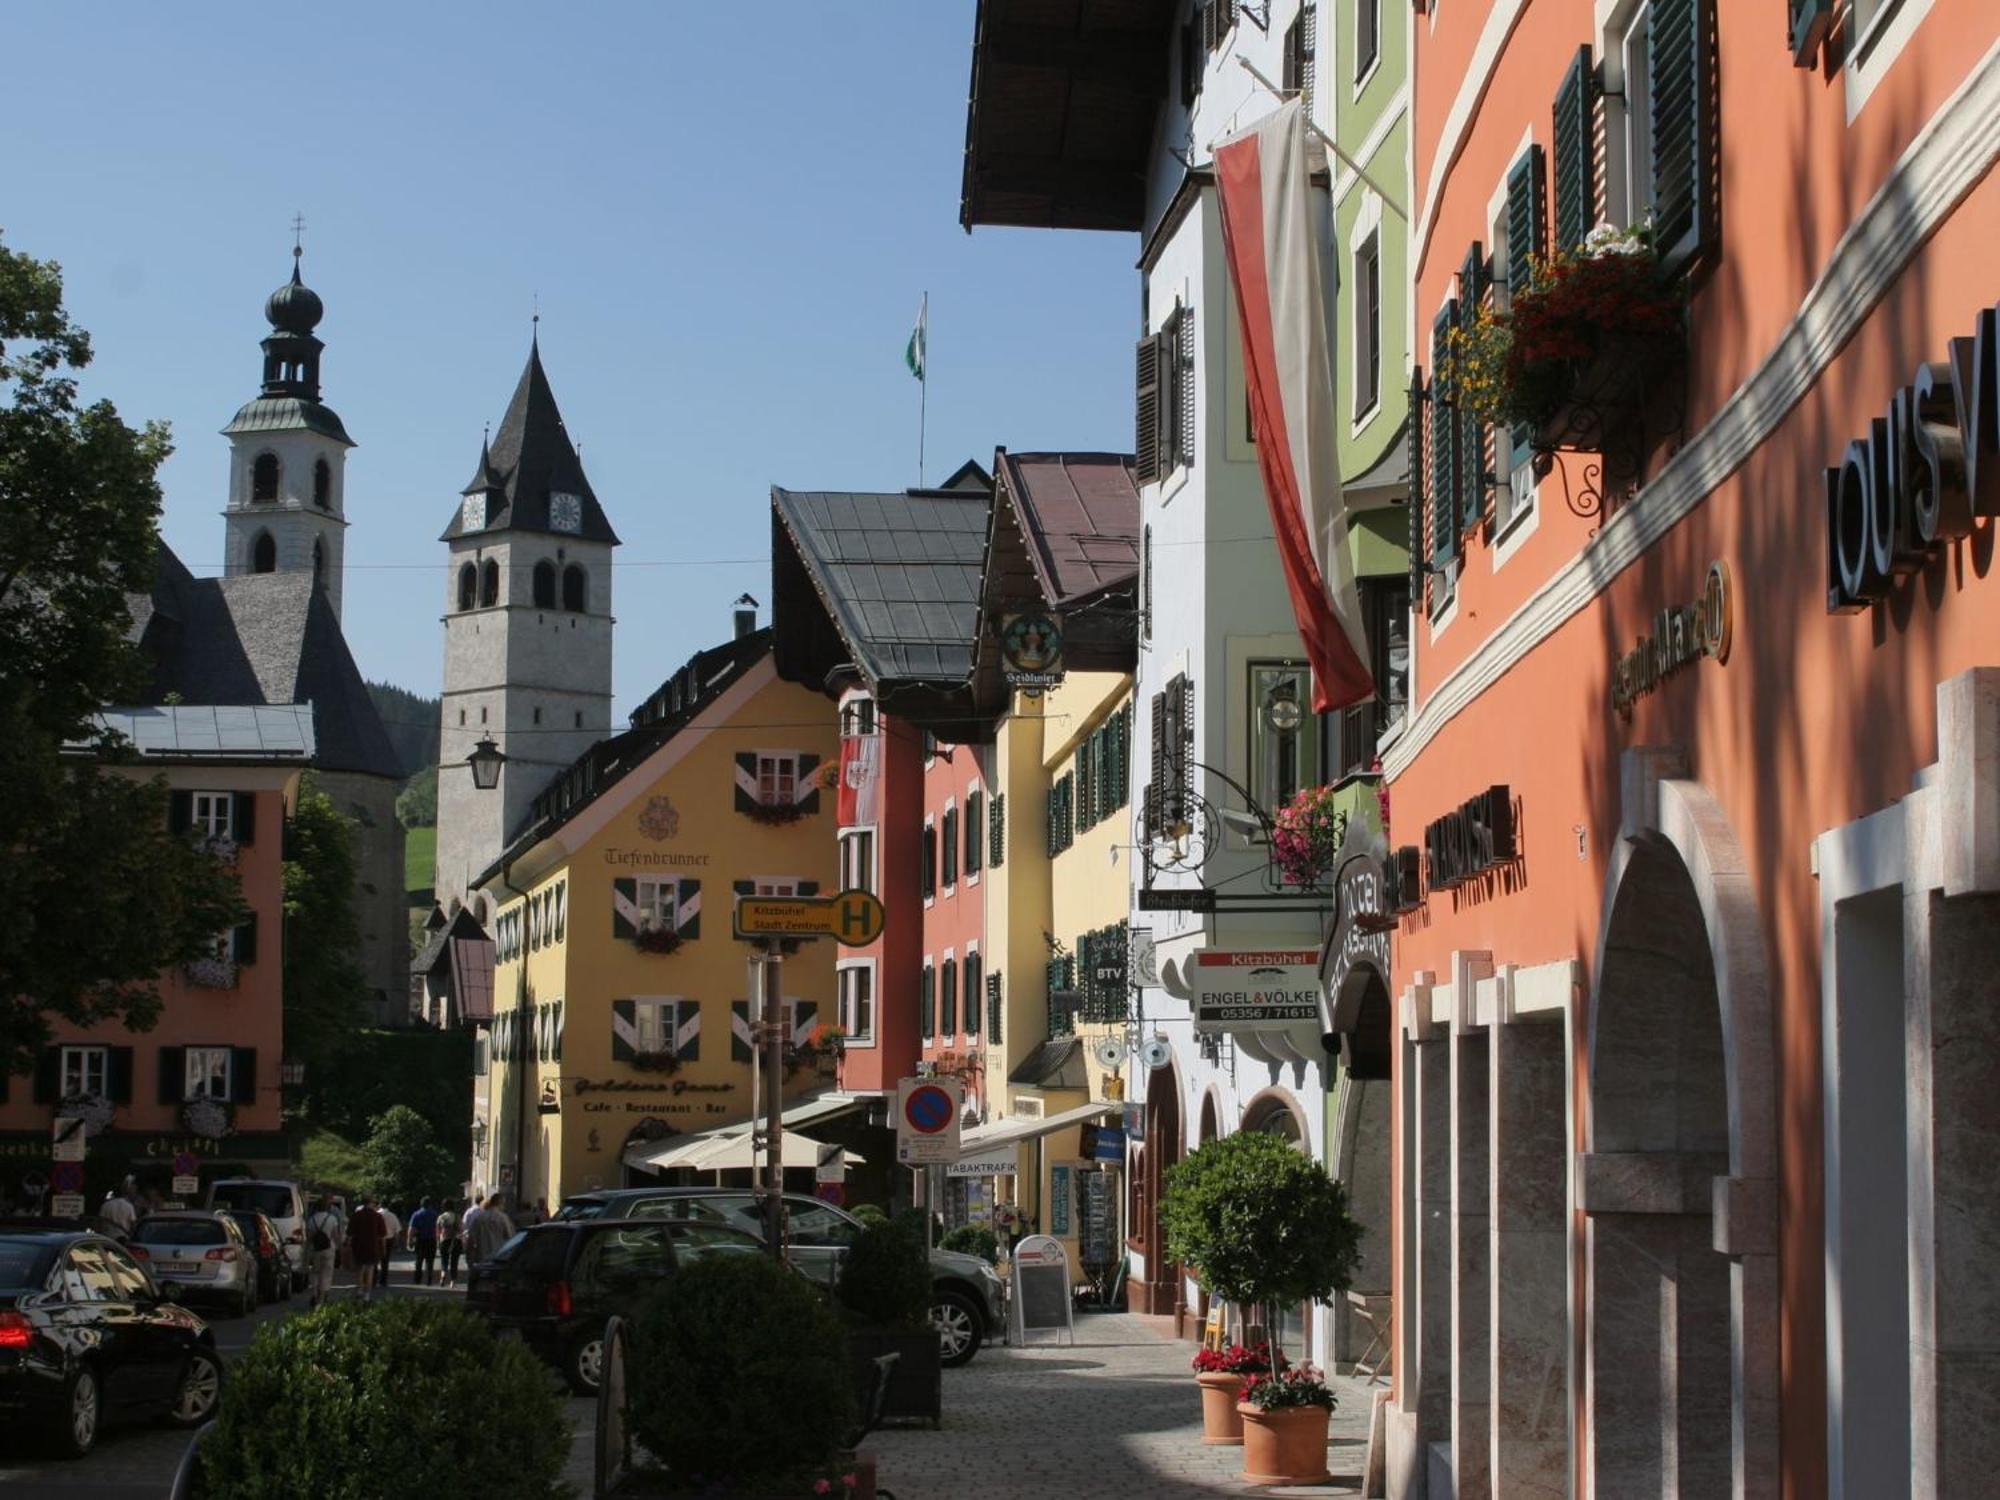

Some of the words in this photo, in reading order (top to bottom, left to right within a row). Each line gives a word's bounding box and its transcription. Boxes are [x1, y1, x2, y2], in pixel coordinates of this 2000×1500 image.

[1825, 360, 1955, 616] LOUIS
[604, 847, 710, 867] Tiefenbrunner
[753, 906, 806, 916] Kitzbühel
[842, 900, 870, 936] H
[753, 921, 782, 930] Stadt
[785, 921, 832, 930] Zentrum
[1231, 953, 1307, 966] Kitzbühel
[1096, 967, 1122, 980] BTV
[1220, 1009, 1262, 1019] 05356
[1276, 1007, 1316, 1018] 71615
[625, 1102, 691, 1114] Restaurant
[705, 1103, 727, 1113] Bar
[946, 1163, 1017, 1174] TABAKTRAFIK
